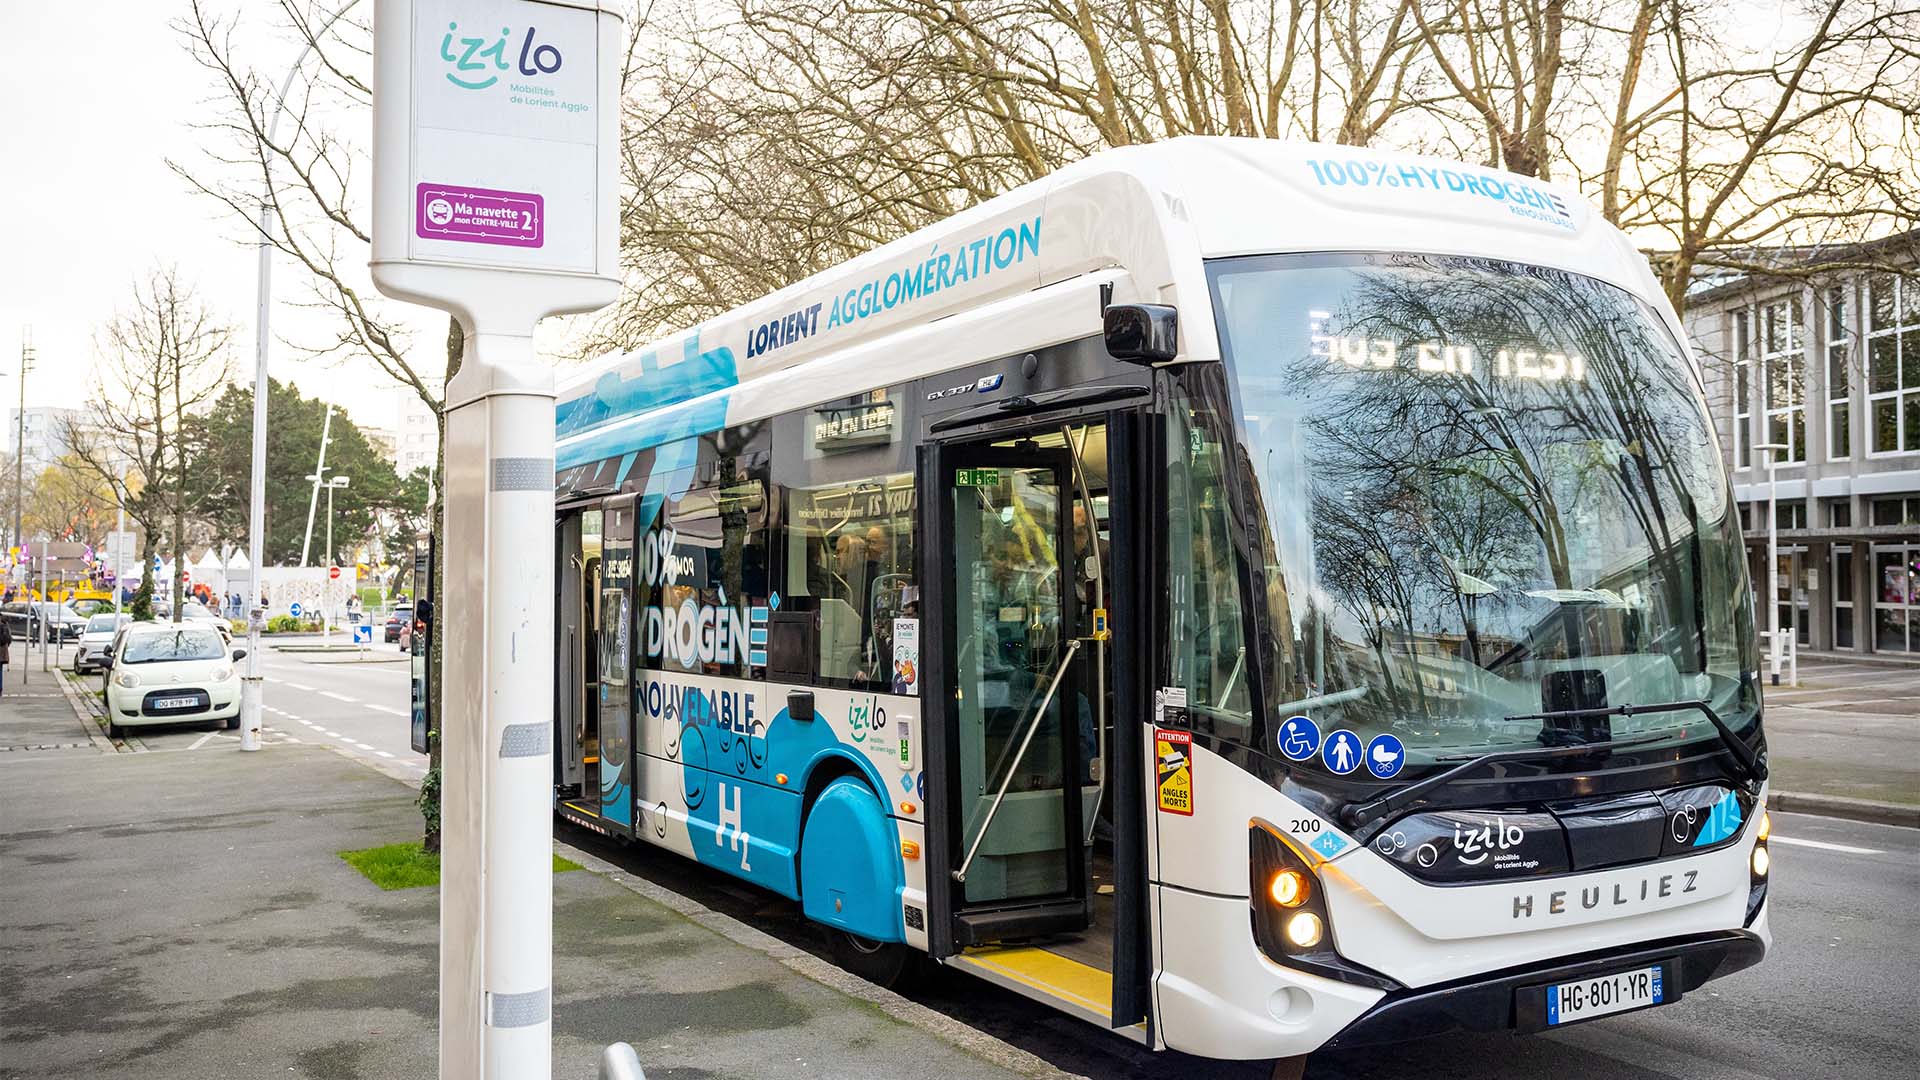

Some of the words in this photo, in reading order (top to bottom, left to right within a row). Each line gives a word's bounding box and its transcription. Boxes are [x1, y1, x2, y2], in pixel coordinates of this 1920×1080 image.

[510, 84, 554, 97] Mobilités
[510, 95, 523, 104] de
[525, 97, 558, 108] Lorient
[561, 101, 589, 113] Agglo
[454, 203, 473, 215] Ma
[475, 205, 518, 219] navette
[454, 217, 471, 225] mon
[471, 218, 518, 229] CENTRE-VILLE
[521, 211, 532, 231] 2
[747, 304, 822, 359] LORIENT
[828, 217, 1042, 330] AGGLOMÉRATION
[928, 391, 946, 401] GX
[948, 383, 976, 396] 337
[1157, 733, 1189, 742] ATTENTION
[1163, 787, 1188, 799] ANGLES
[1164, 797, 1187, 808] MORTS
[1291, 819, 1320, 833] 200
[1494, 854, 1520, 862] Mobilités
[1503, 861, 1521, 869] Lorient
[1522, 860, 1539, 870] Agglo
[1513, 870, 1698, 918] HEULIEZ
[1561, 973, 1649, 1013] HG-801-YR
[1653, 985, 1661, 997] 56
